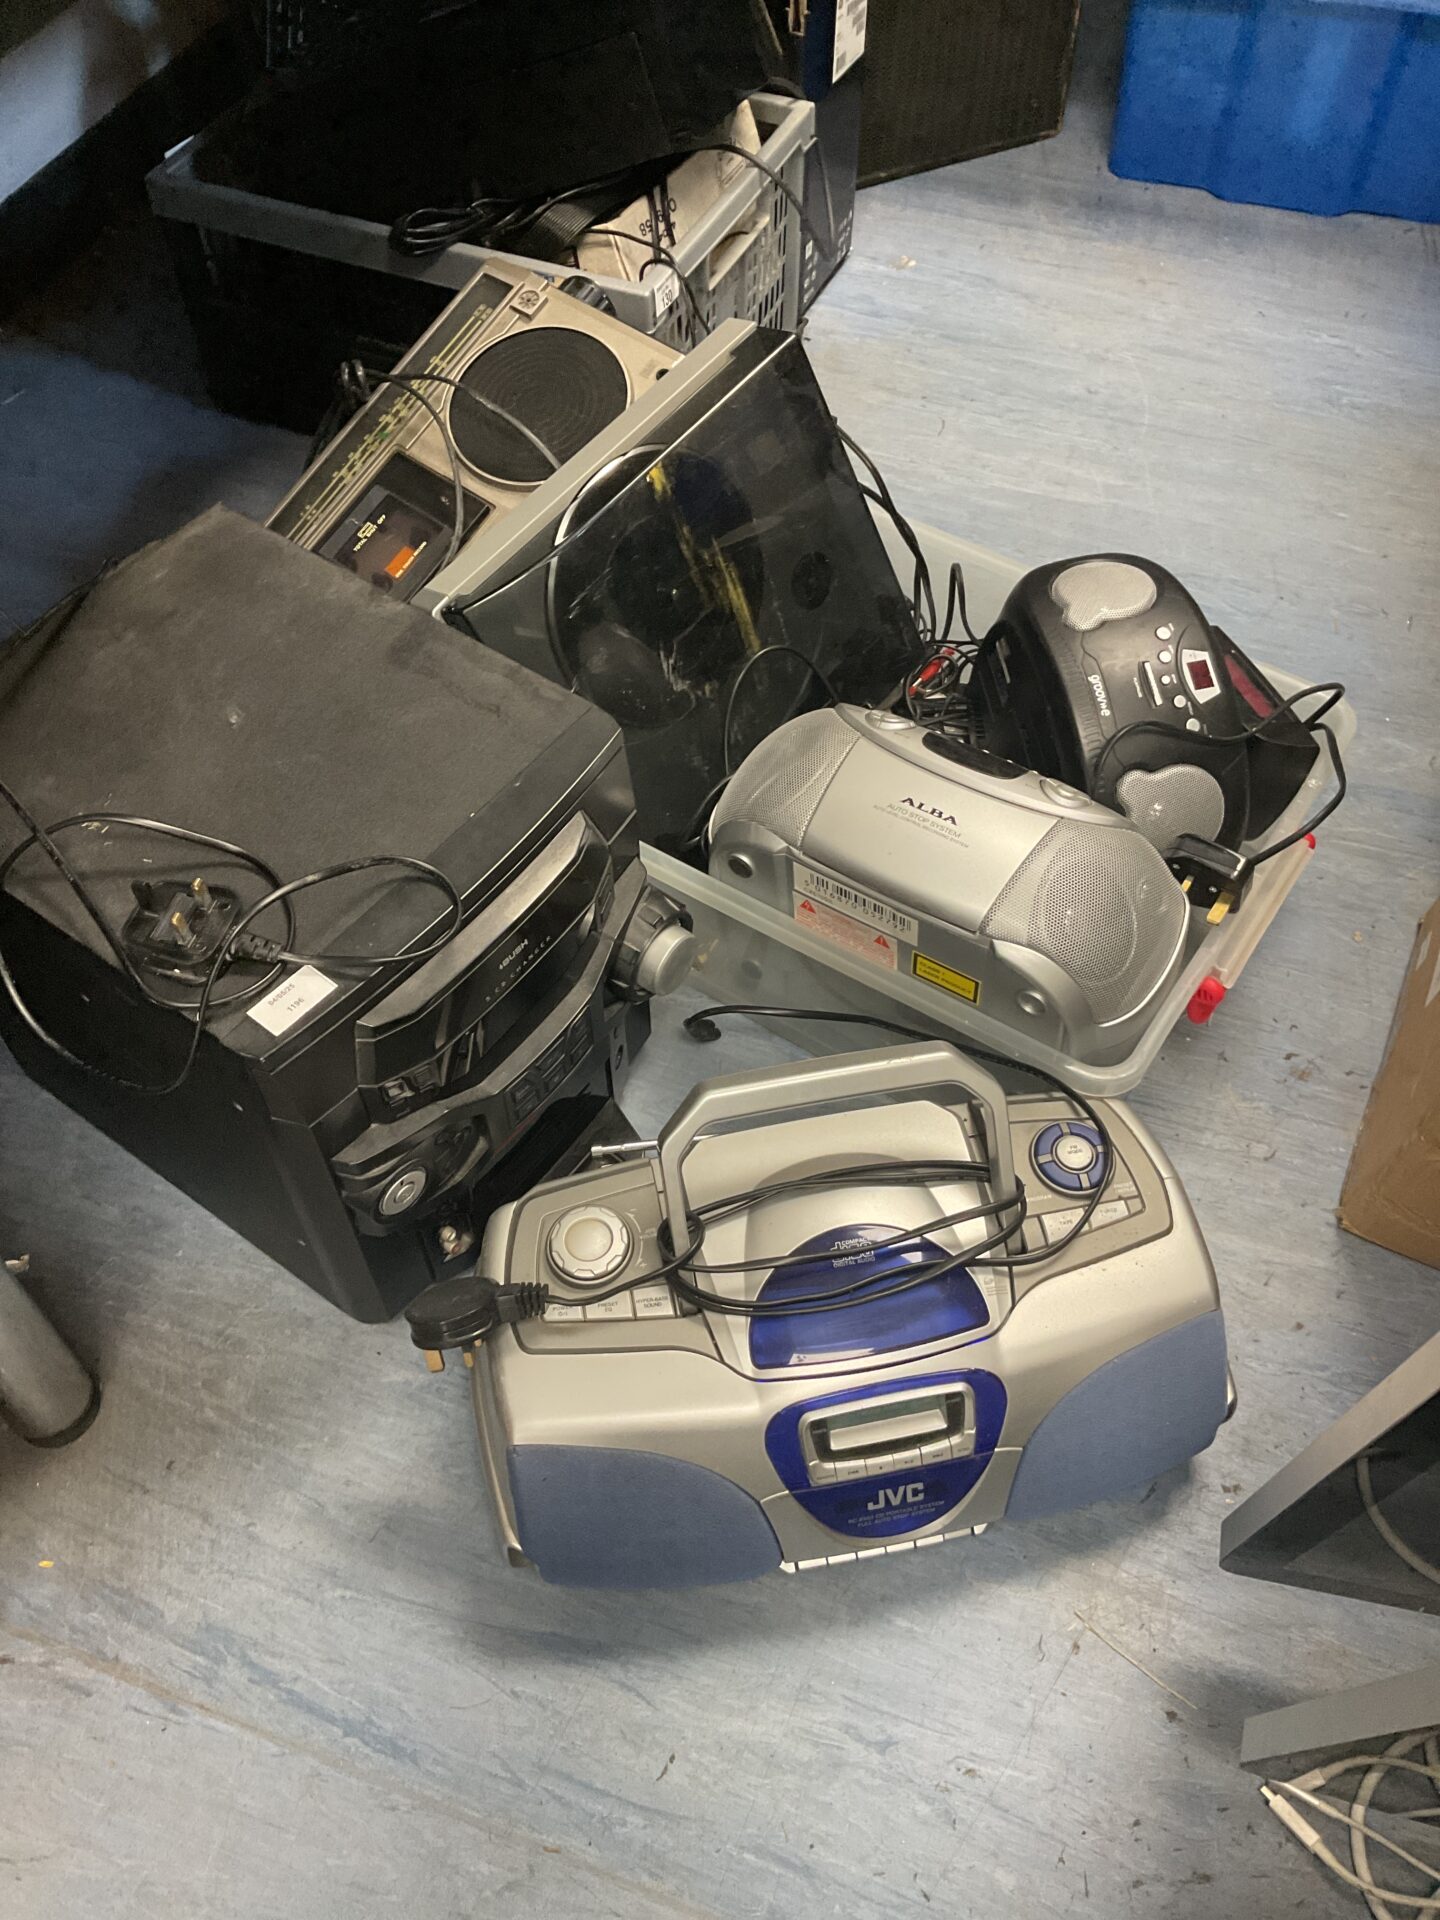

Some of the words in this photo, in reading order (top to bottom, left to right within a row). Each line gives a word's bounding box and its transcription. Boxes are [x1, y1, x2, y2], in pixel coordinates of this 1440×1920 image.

[662, 289, 673, 308] 130
[377, 514, 386, 525] OFF
[887, 803, 909, 816] AUTO
[908, 811, 930, 823] STOP
[929, 821, 962, 839] SYSTEM
[900, 797, 958, 826] ALBA
[502, 938, 529, 967] BUSH
[510, 935, 551, 978] CHANGER
[833, 1260, 857, 1269] DIGITAL
[857, 1256, 876, 1265] AUDIO
[597, 1301, 619, 1309] PRESET
[867, 1482, 925, 1511] JVC
